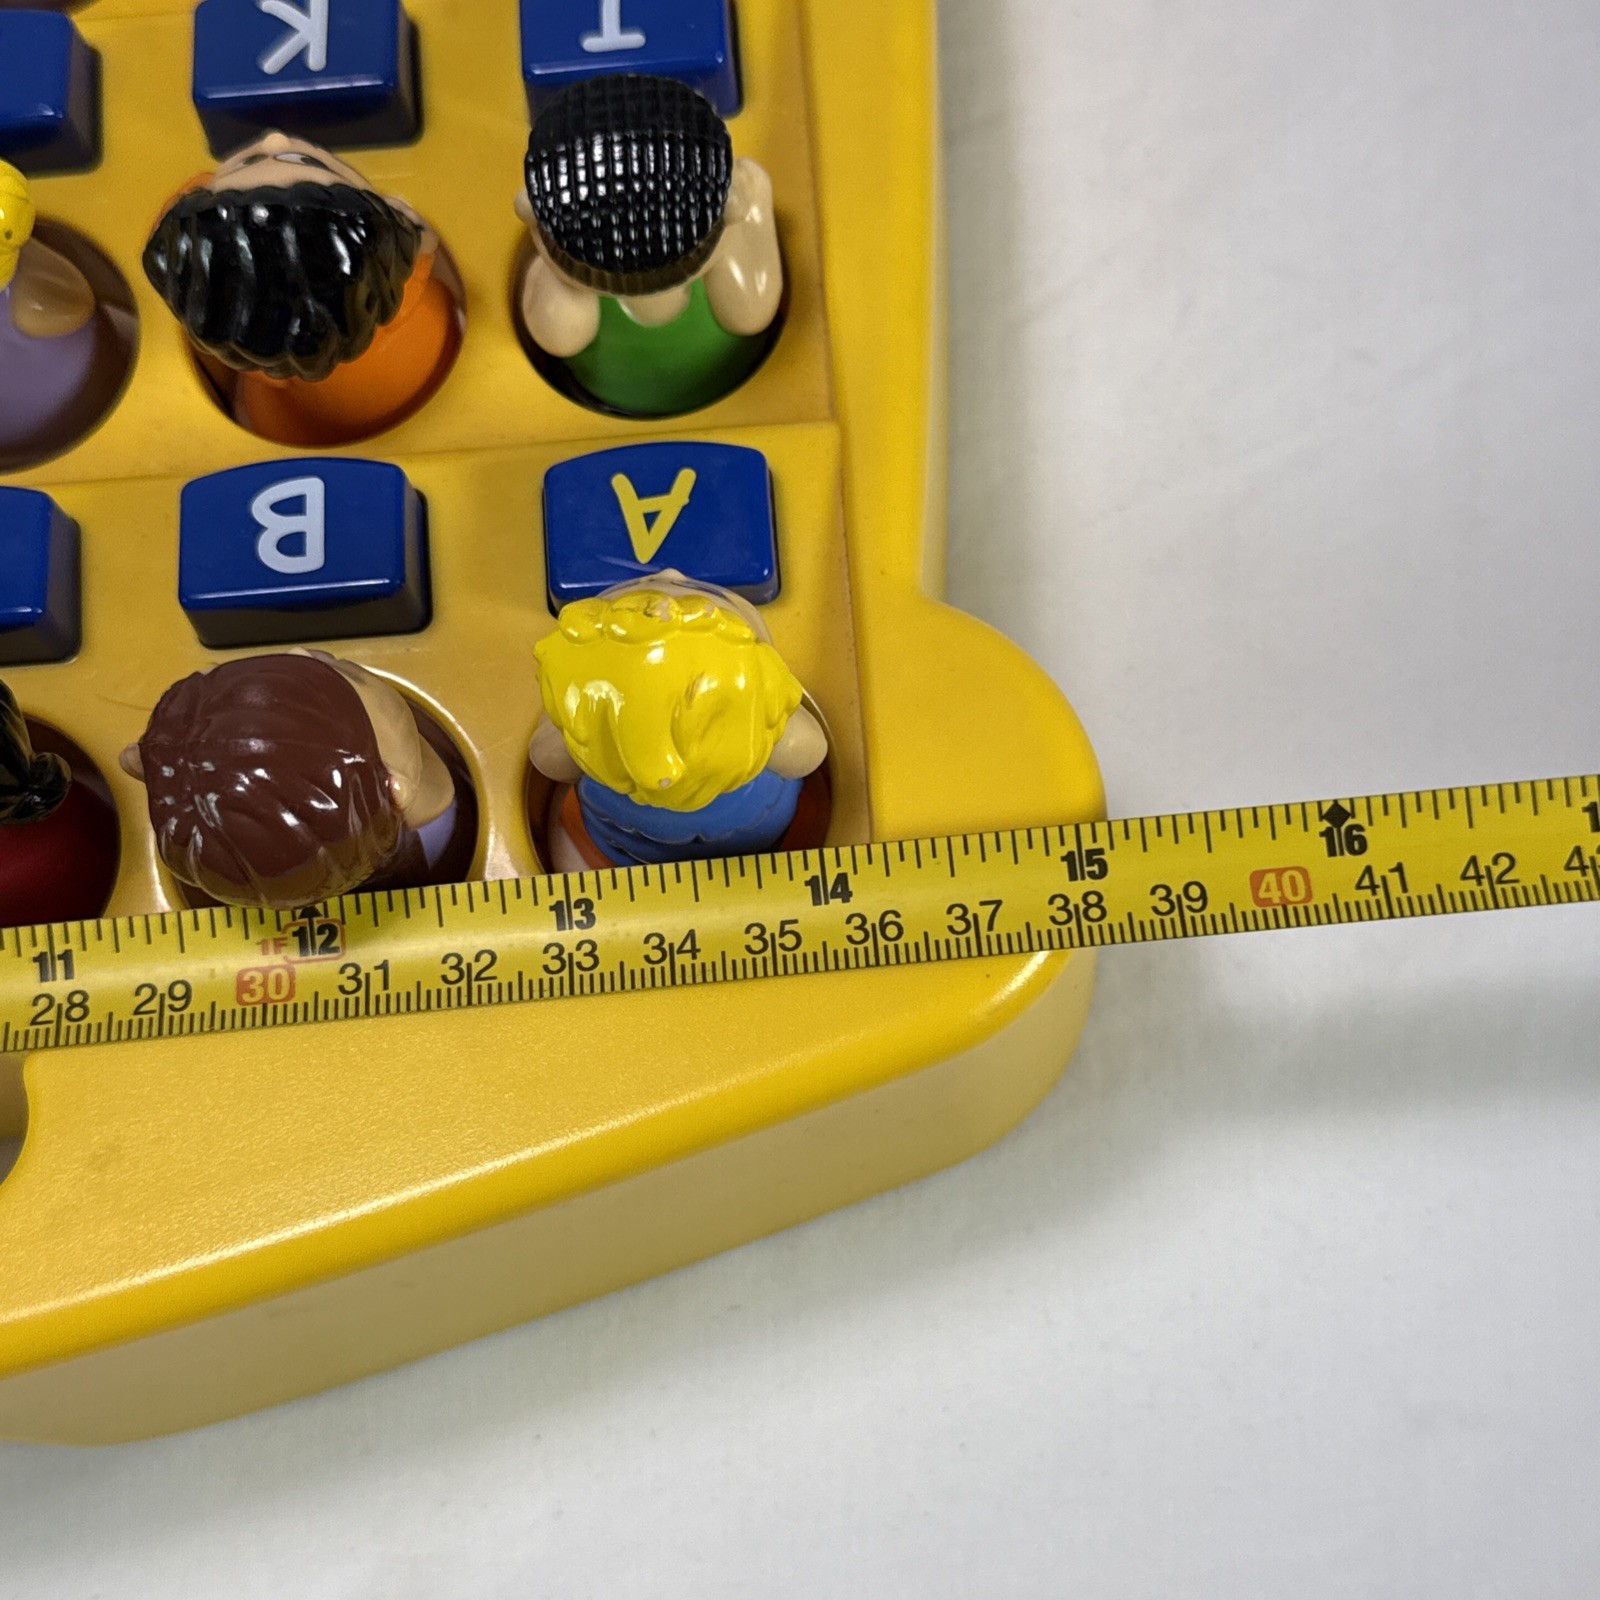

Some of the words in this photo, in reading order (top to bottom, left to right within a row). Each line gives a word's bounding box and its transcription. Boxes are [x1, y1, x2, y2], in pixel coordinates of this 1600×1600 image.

[258, 0, 328, 73] K
[250, 476, 325, 574] B
[611, 467, 697, 564] A
[30, 989, 90, 1026] 28
[134, 979, 193, 1016] 29
[241, 966, 292, 1002] 30
[338, 959, 391, 995] 31
[440, 948, 498, 985] 32
[542, 938, 600, 975] 33
[643, 929, 700, 965] 34
[744, 918, 802, 955] 35
[845, 909, 904, 945] 36
[946, 899, 1003, 936] 37
[1048, 890, 1108, 926] 38
[1150, 880, 1208, 917] 39
[1257, 869, 1304, 906] 40
[1354, 861, 1409, 896] 41
[1460, 851, 1520, 887] 42
[33, 948, 76, 983] 11
[291, 921, 341, 957] 12
[549, 897, 597, 931] 13
[804, 872, 853, 906] 14
[1060, 847, 1109, 882] 15
[1319, 823, 1369, 858] 16
